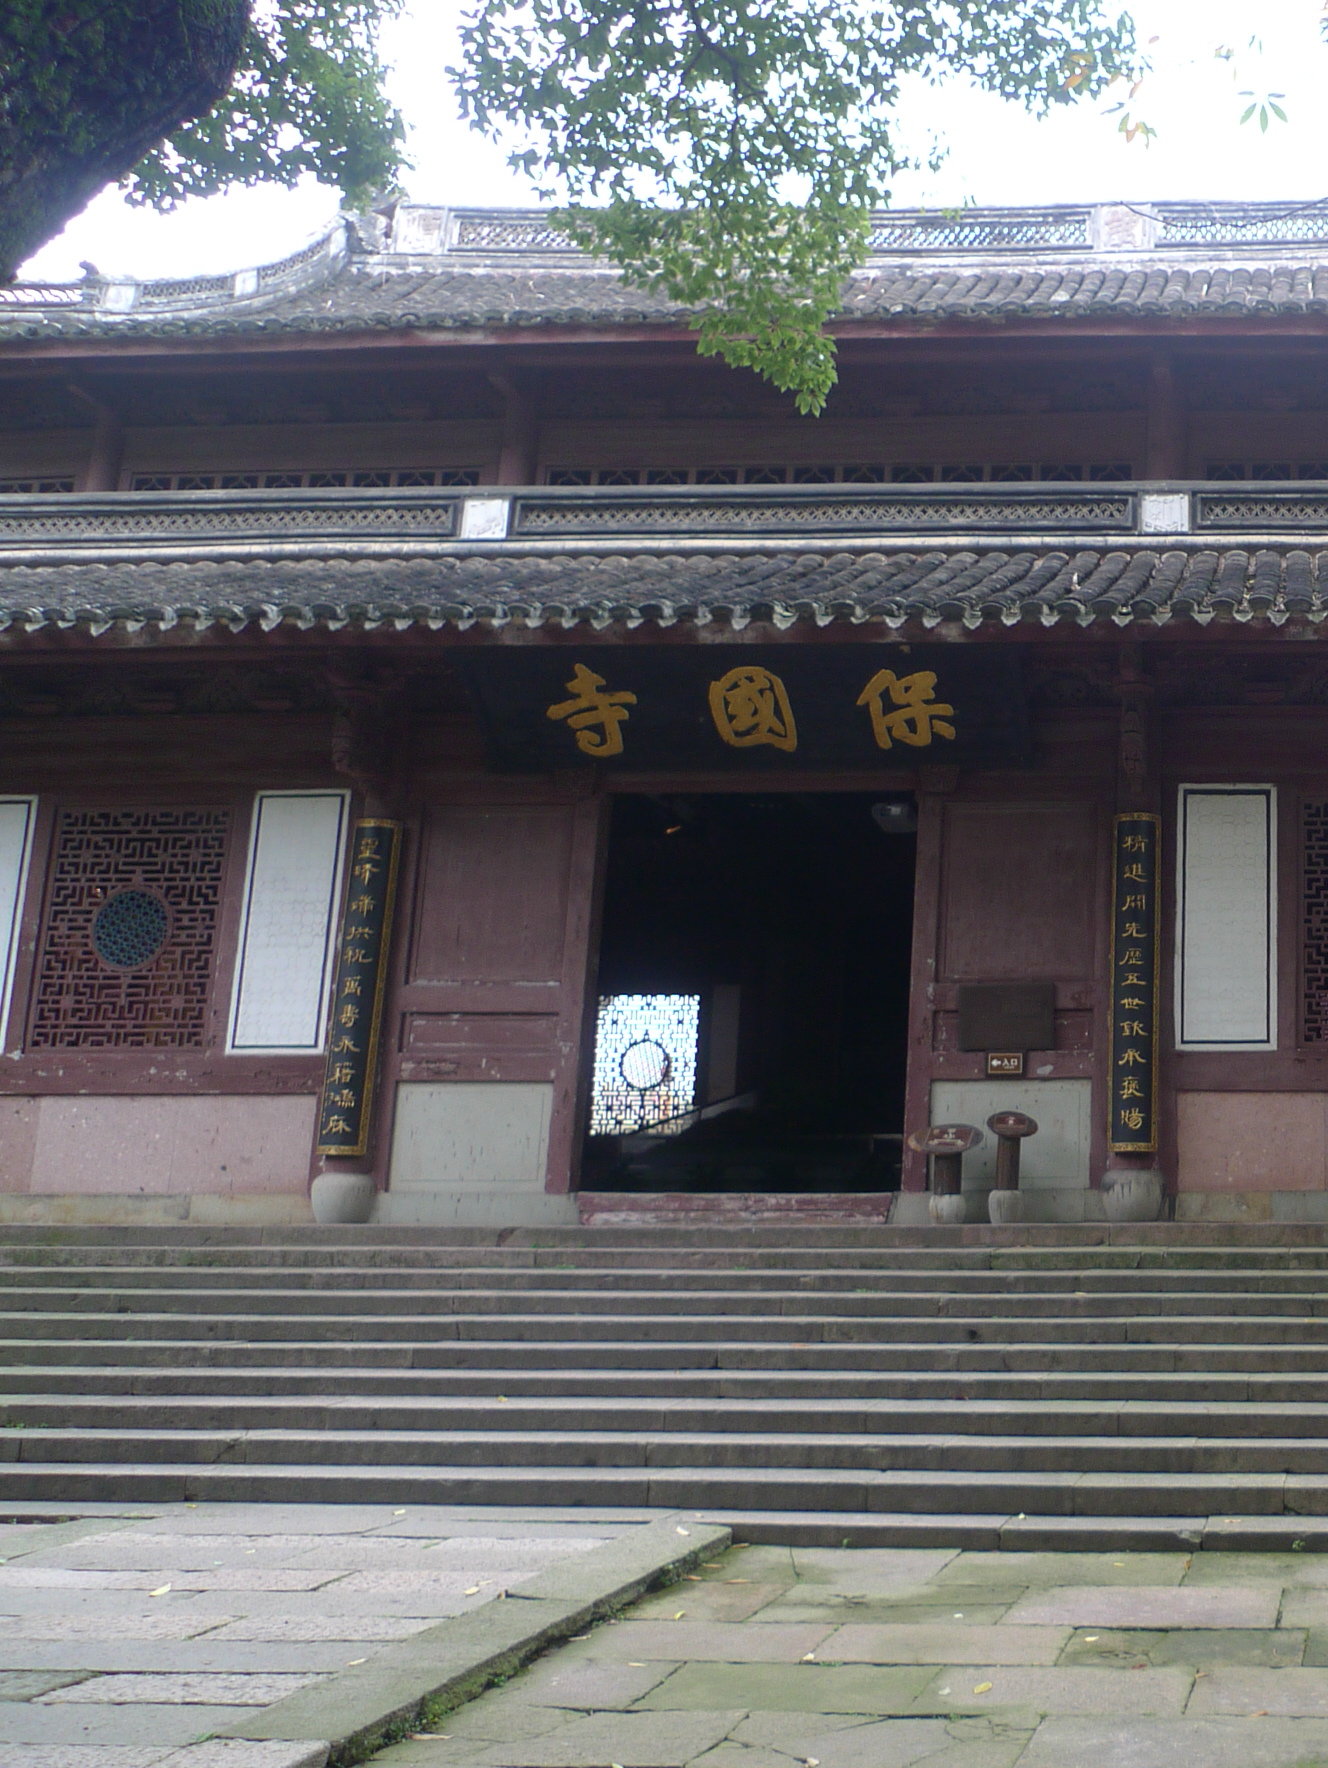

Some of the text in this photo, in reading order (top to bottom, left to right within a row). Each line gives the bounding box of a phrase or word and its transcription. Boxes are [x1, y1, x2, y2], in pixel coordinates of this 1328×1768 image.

[547, 663, 957, 757] 保國寺
[1002, 1058, 1018, 1066] 入口
